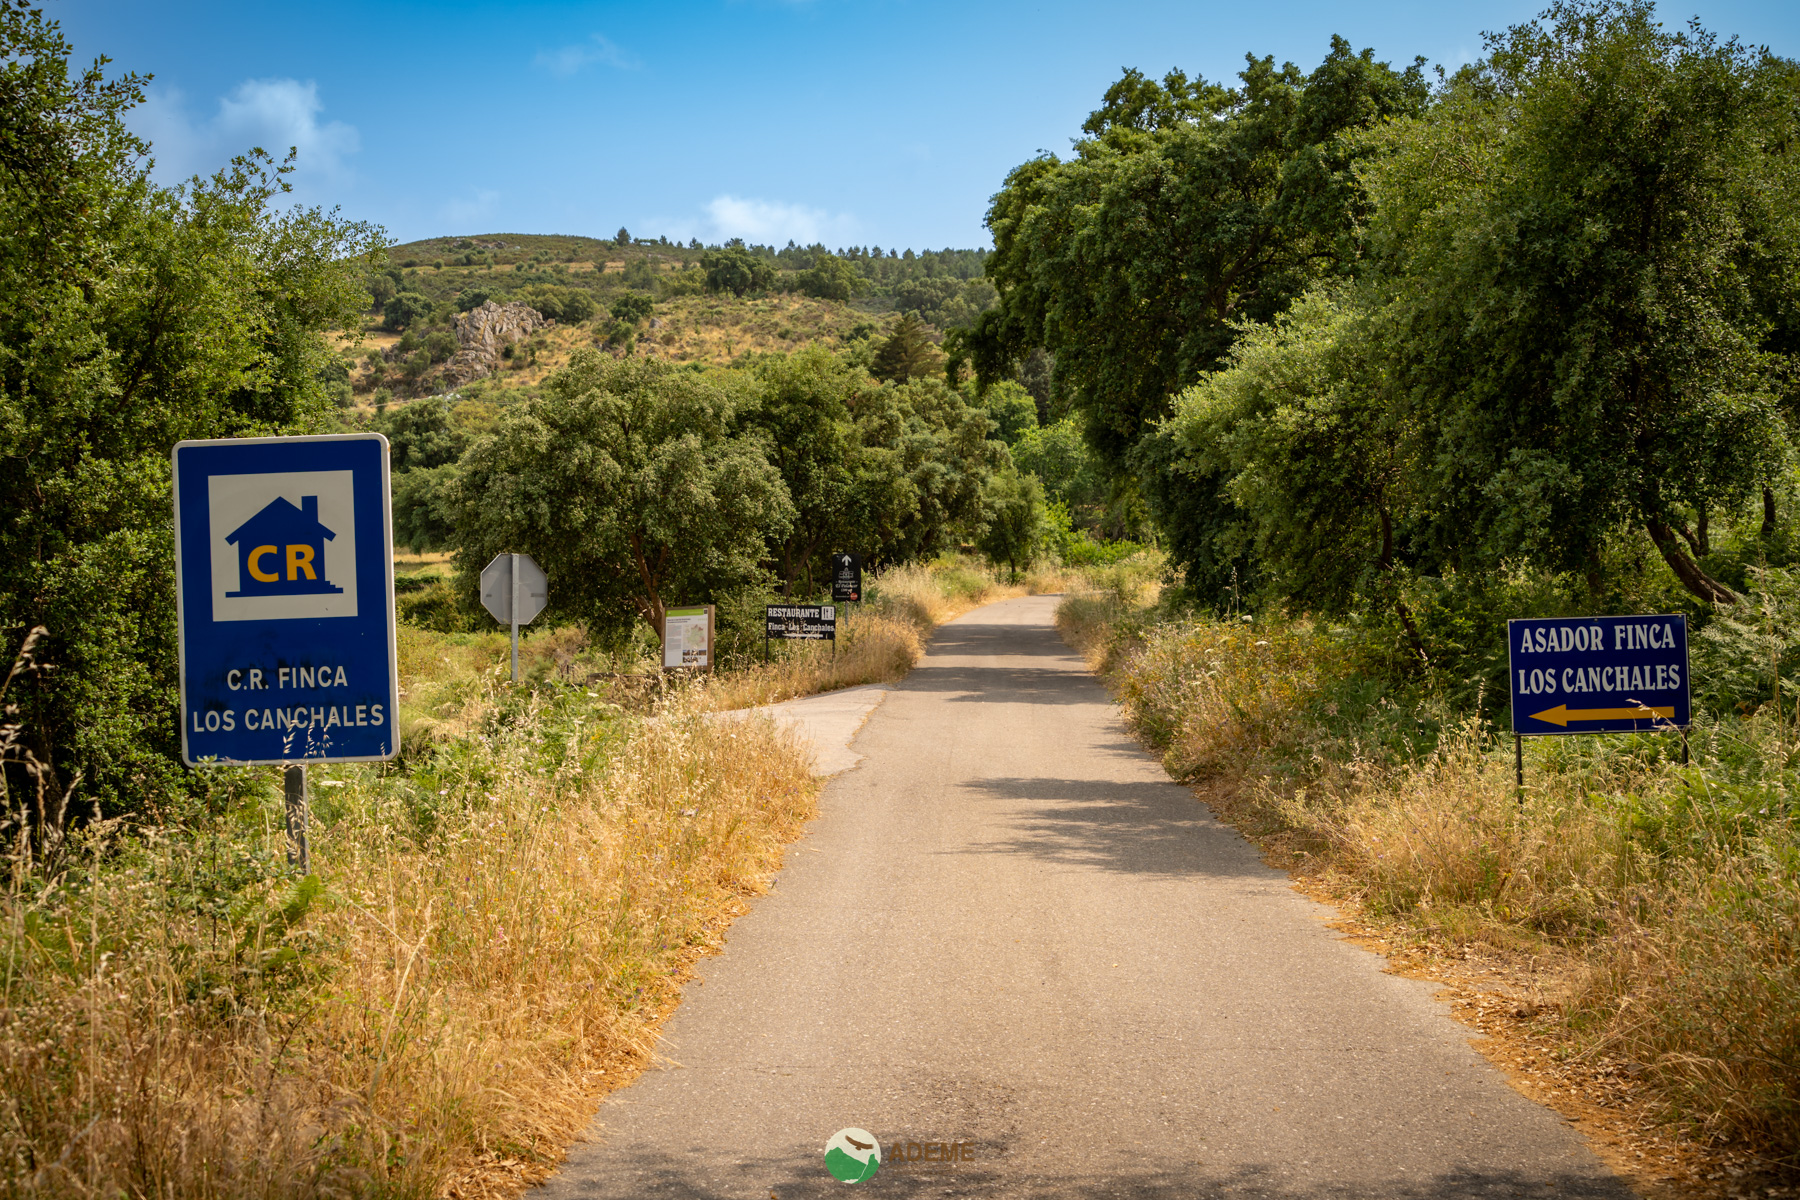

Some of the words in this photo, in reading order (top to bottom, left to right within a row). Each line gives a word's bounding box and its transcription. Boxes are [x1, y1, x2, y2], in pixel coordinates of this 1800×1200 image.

[247, 544, 318, 583] CR
[768, 607, 820, 618] RESTAURANTE
[768, 622, 786, 631] Finca
[802, 623, 835, 632] Canchales
[1521, 626, 1604, 653] ASADOR
[1614, 623, 1676, 650] FINCA
[227, 668, 269, 691] C.R.
[278, 666, 348, 689] FINCA
[1518, 668, 1557, 695] LOS
[1562, 664, 1681, 694] CANCHALES
[193, 709, 236, 733] LOS
[244, 704, 385, 731] CANCHALES
